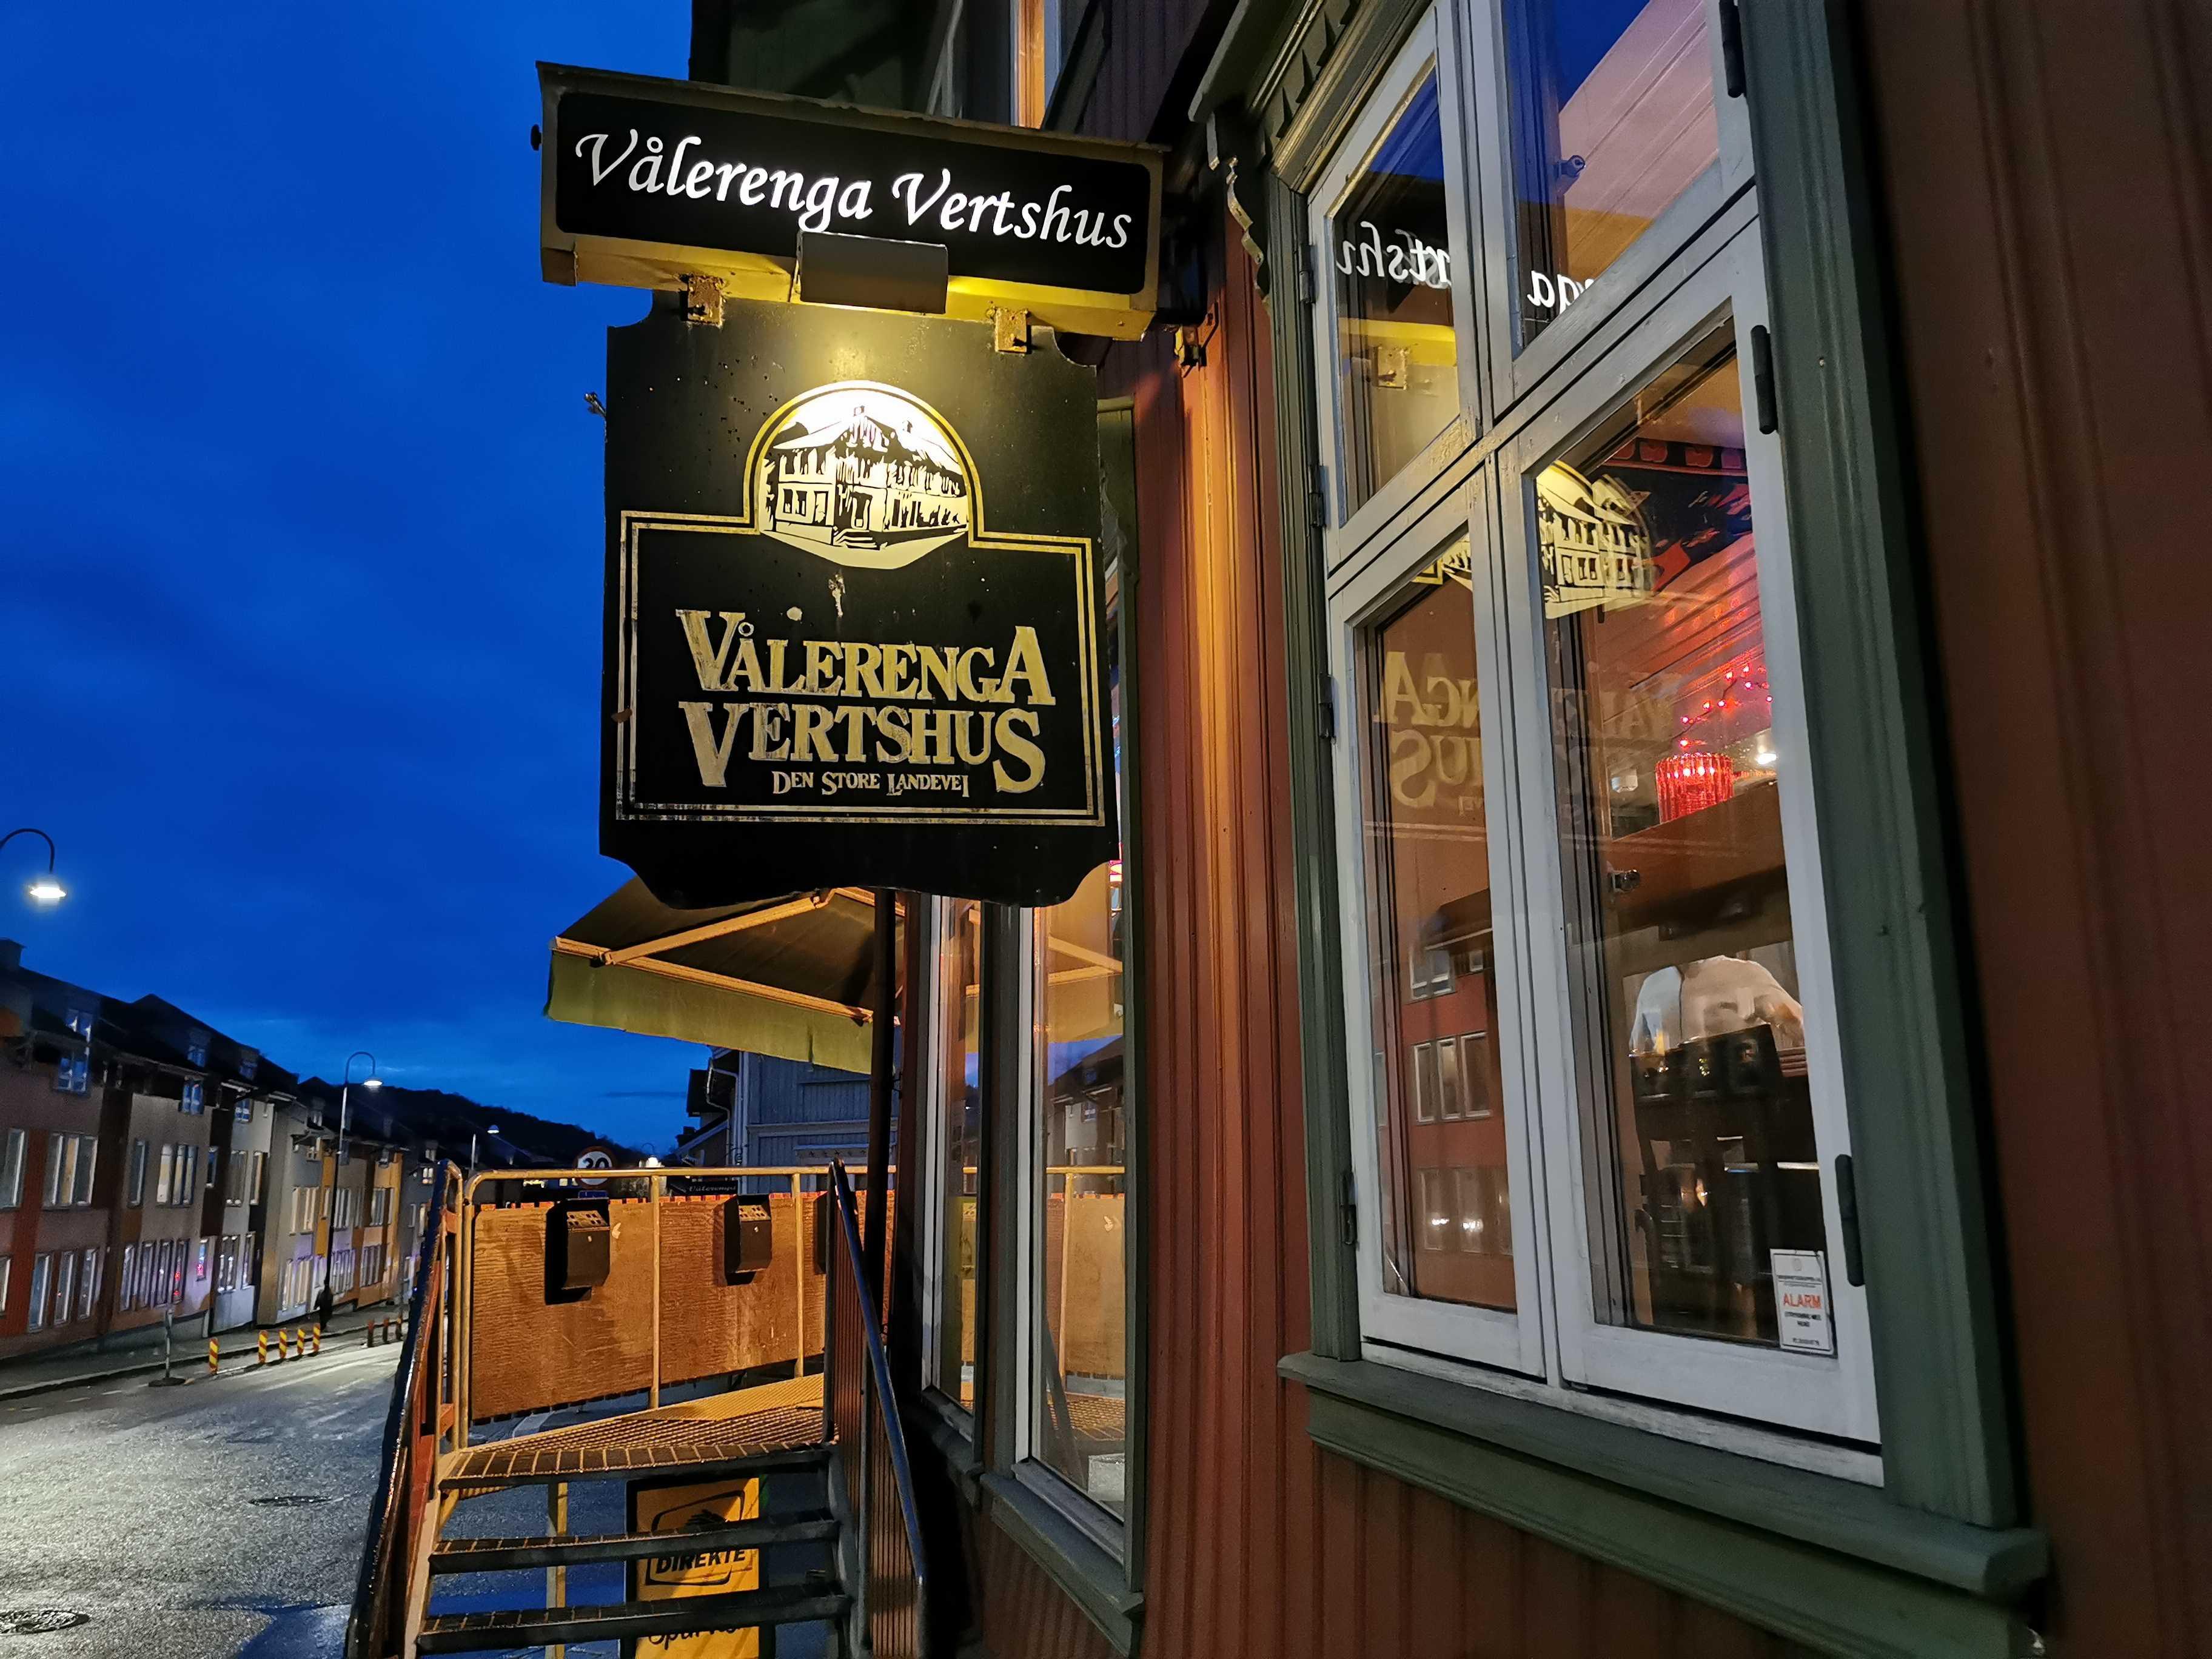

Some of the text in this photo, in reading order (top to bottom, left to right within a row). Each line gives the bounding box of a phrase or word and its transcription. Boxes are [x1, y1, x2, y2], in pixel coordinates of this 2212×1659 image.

[575, 129, 1131, 249] Vålerenga Vertshus
[675, 609, 1056, 706] VÅLERENGA
[679, 701, 1045, 793] VERTSHUS
[771, 771, 814, 794] DEN
[822, 771, 880, 795] STORE
[1783, 1293, 1822, 1309] ALARM
